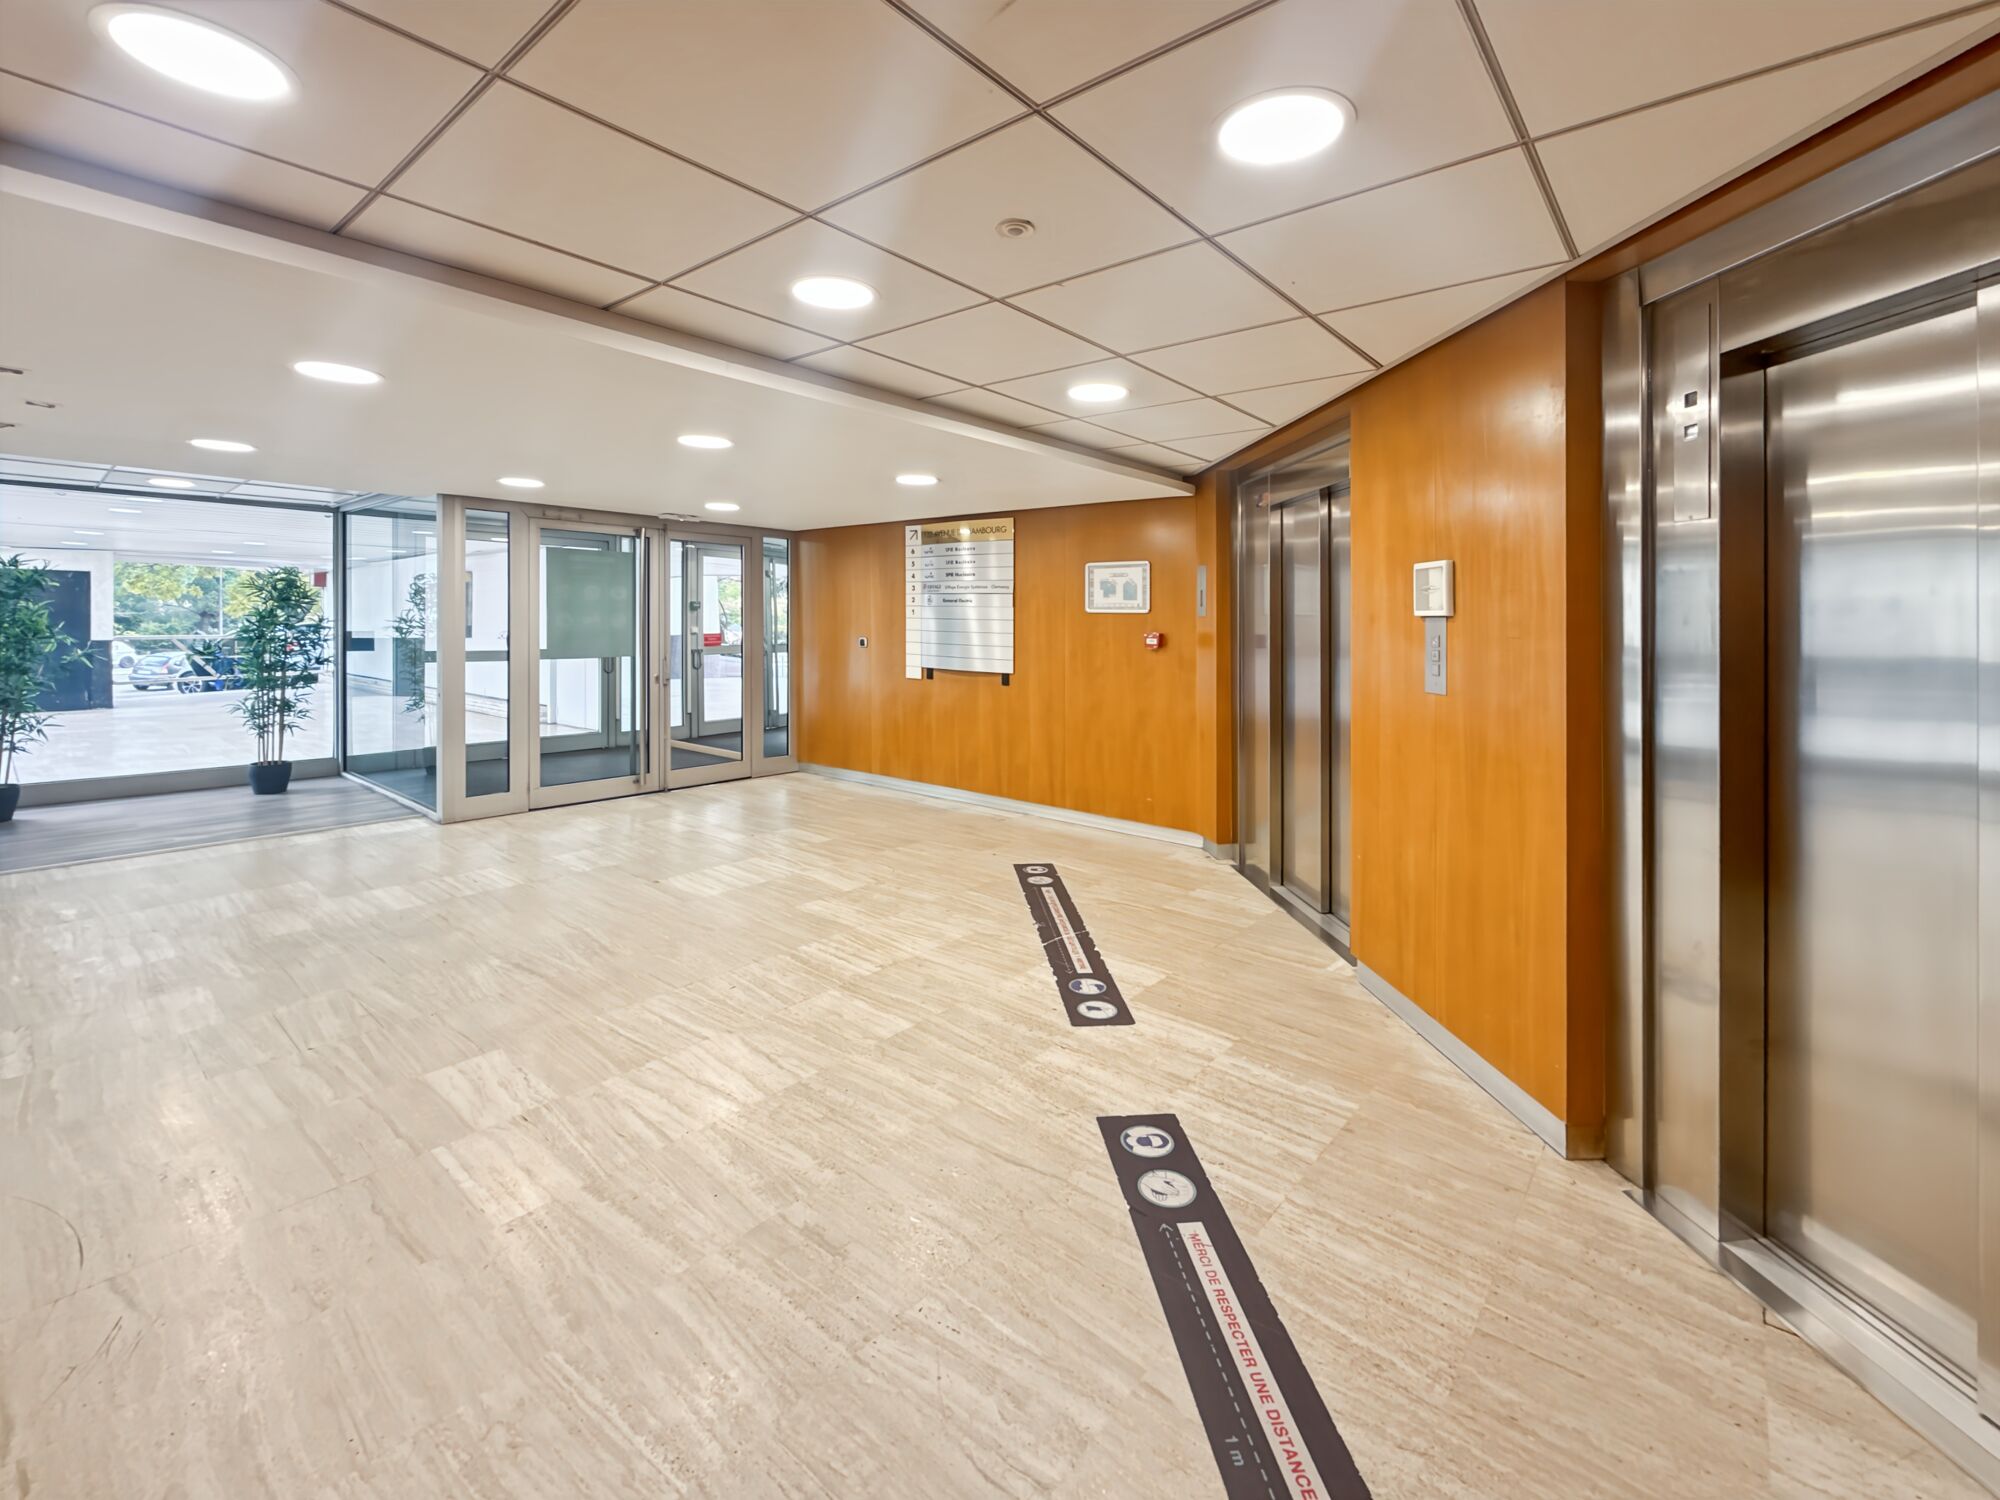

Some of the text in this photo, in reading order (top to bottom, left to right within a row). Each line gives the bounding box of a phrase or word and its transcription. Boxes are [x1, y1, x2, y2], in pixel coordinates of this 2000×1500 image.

[1188, 1231, 1318, 1500] MERCI DE RESPECTER UNE DISTANCE
[1224, 1435, 1244, 1467] 1 m
